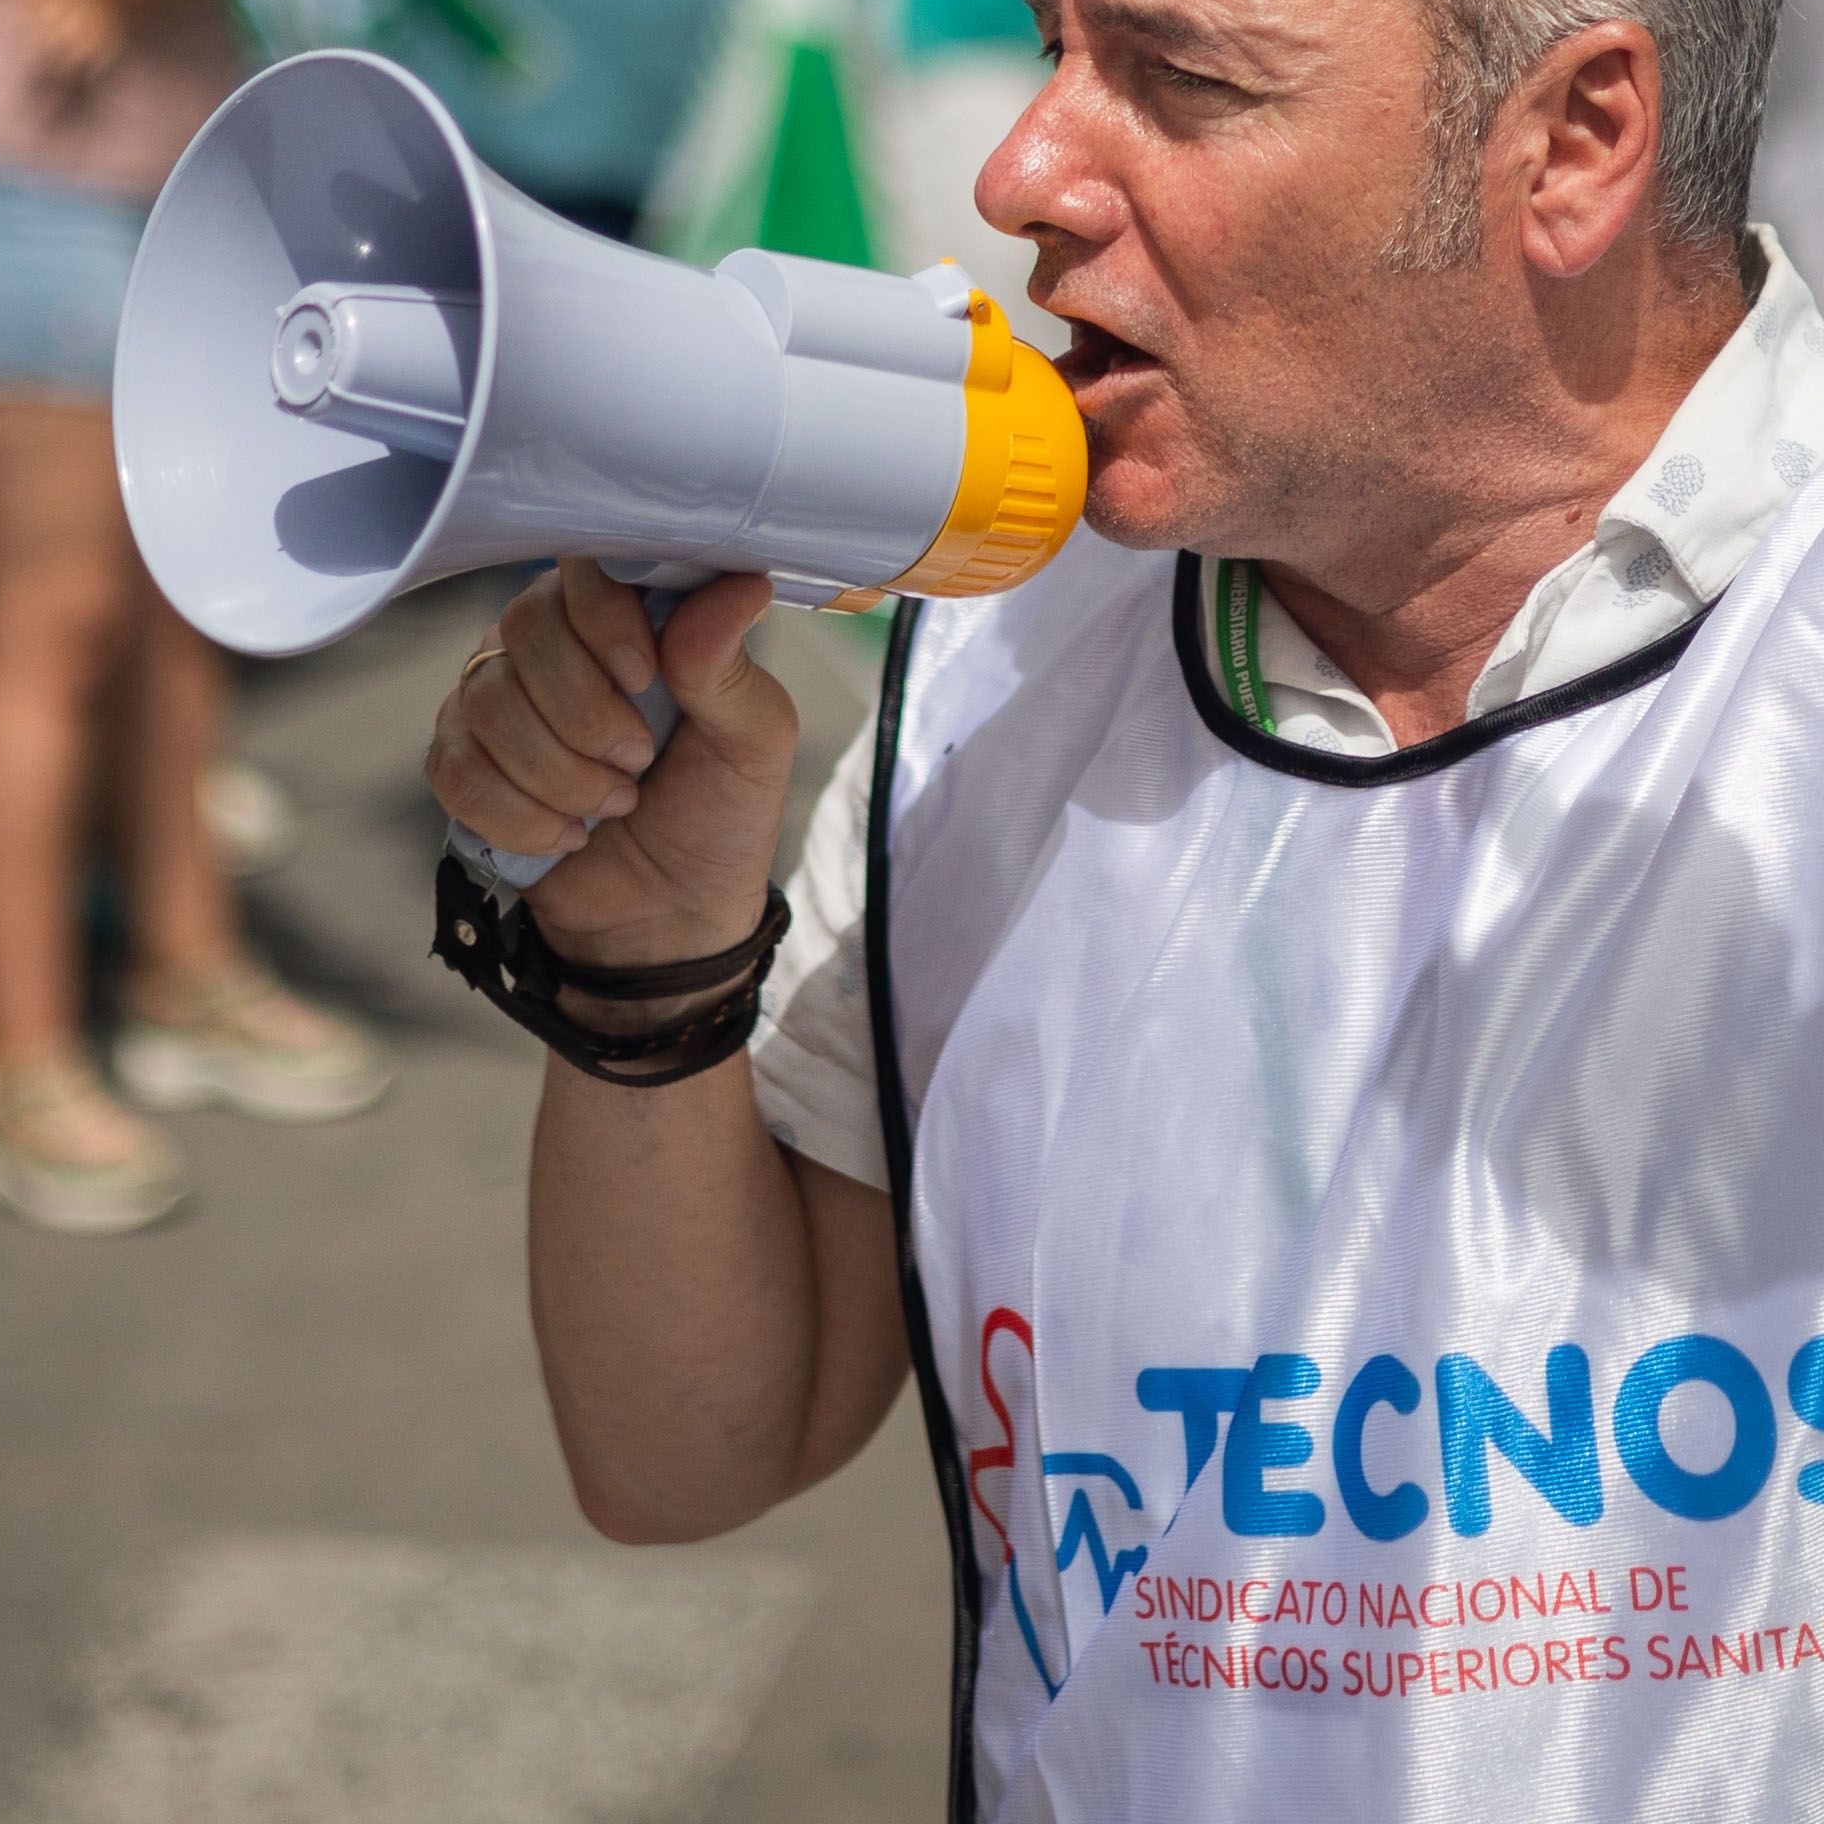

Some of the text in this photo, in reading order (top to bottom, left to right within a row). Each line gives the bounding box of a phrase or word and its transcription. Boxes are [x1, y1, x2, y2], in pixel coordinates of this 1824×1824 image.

[1134, 1565, 1689, 1629] SINDICATO NACIONAL DE
[1140, 1631, 1329, 1693] TÉCNICOS
[1342, 1635, 1631, 1697] SUPERIORES
